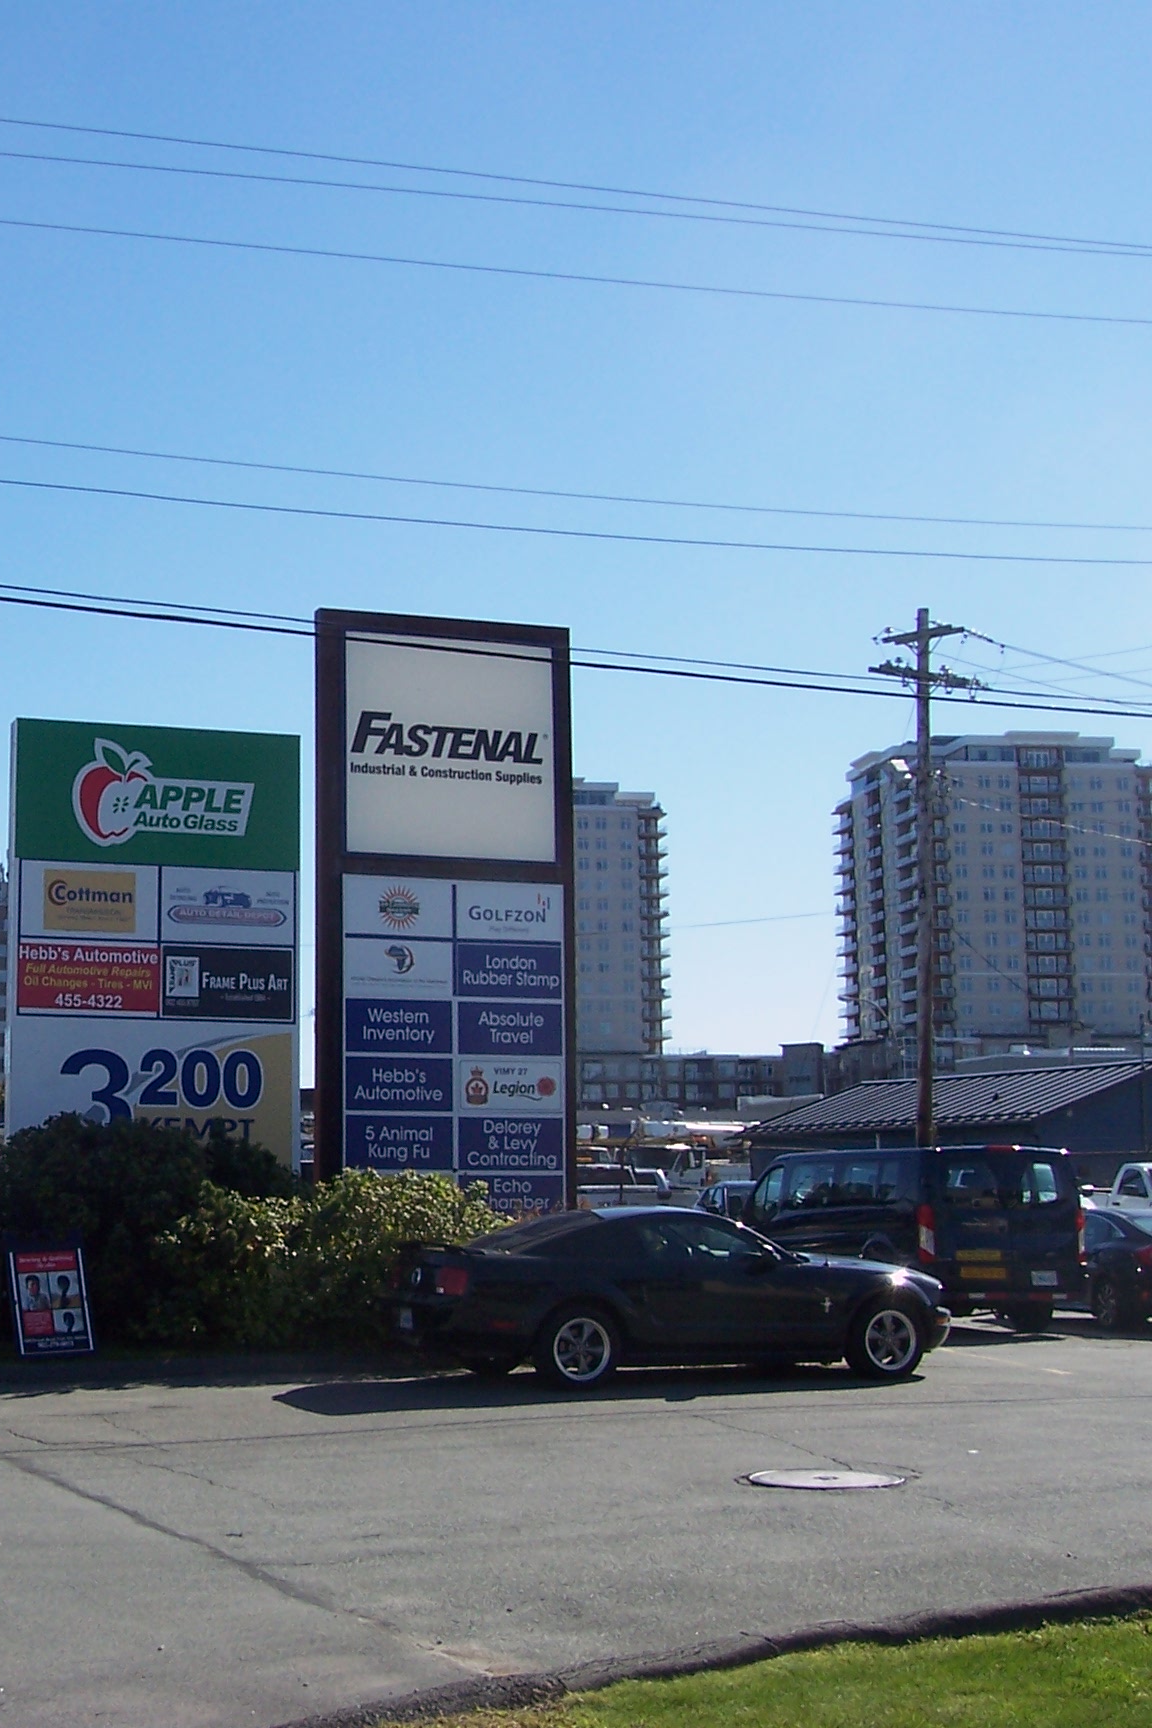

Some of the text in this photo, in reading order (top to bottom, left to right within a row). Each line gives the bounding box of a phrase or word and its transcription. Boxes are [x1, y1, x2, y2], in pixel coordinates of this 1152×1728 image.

[350, 710, 543, 765] FASTENAL
[350, 762, 543, 785] Industrial & Construction Supplies
[133, 784, 246, 814] APPLE
[133, 811, 239, 832] Auto Glass
[51, 883, 133, 904] Cottman
[179, 908, 207, 917] AUTO
[468, 905, 546, 923] GOLFZON
[19, 945, 159, 964] Hebb's Automotive
[485, 954, 537, 970] London
[25, 963, 151, 978] Full Automotive Repairs
[23, 976, 39, 986] Oil
[41, 976, 88, 990] Changes
[98, 978, 124, 989] Tires
[202, 971, 289, 991] FRAME PLUS ART
[463, 969, 513, 985] Rubber
[516, 972, 560, 990] Stamp
[54, 993, 123, 1008] 455-4322
[367, 1007, 430, 1024] Western
[478, 1011, 545, 1028] Absolute
[363, 1025, 435, 1045] Inventory
[490, 1028, 534, 1044] Travel
[372, 1067, 427, 1084] Hebb's
[493, 1067, 528, 1076] VIMY 27
[354, 1085, 443, 1101] Automotive
[492, 1081, 536, 1098] Legion
[365, 1125, 433, 1141] 5 Animal
[483, 1119, 542, 1138] Delorey
[368, 1143, 430, 1162] Kung Fu
[488, 1135, 538, 1154] & Levy
[467, 1151, 557, 1169] Contracting
[493, 1178, 532, 1193] Echo
[488, 1195, 550, 1210] hamber
